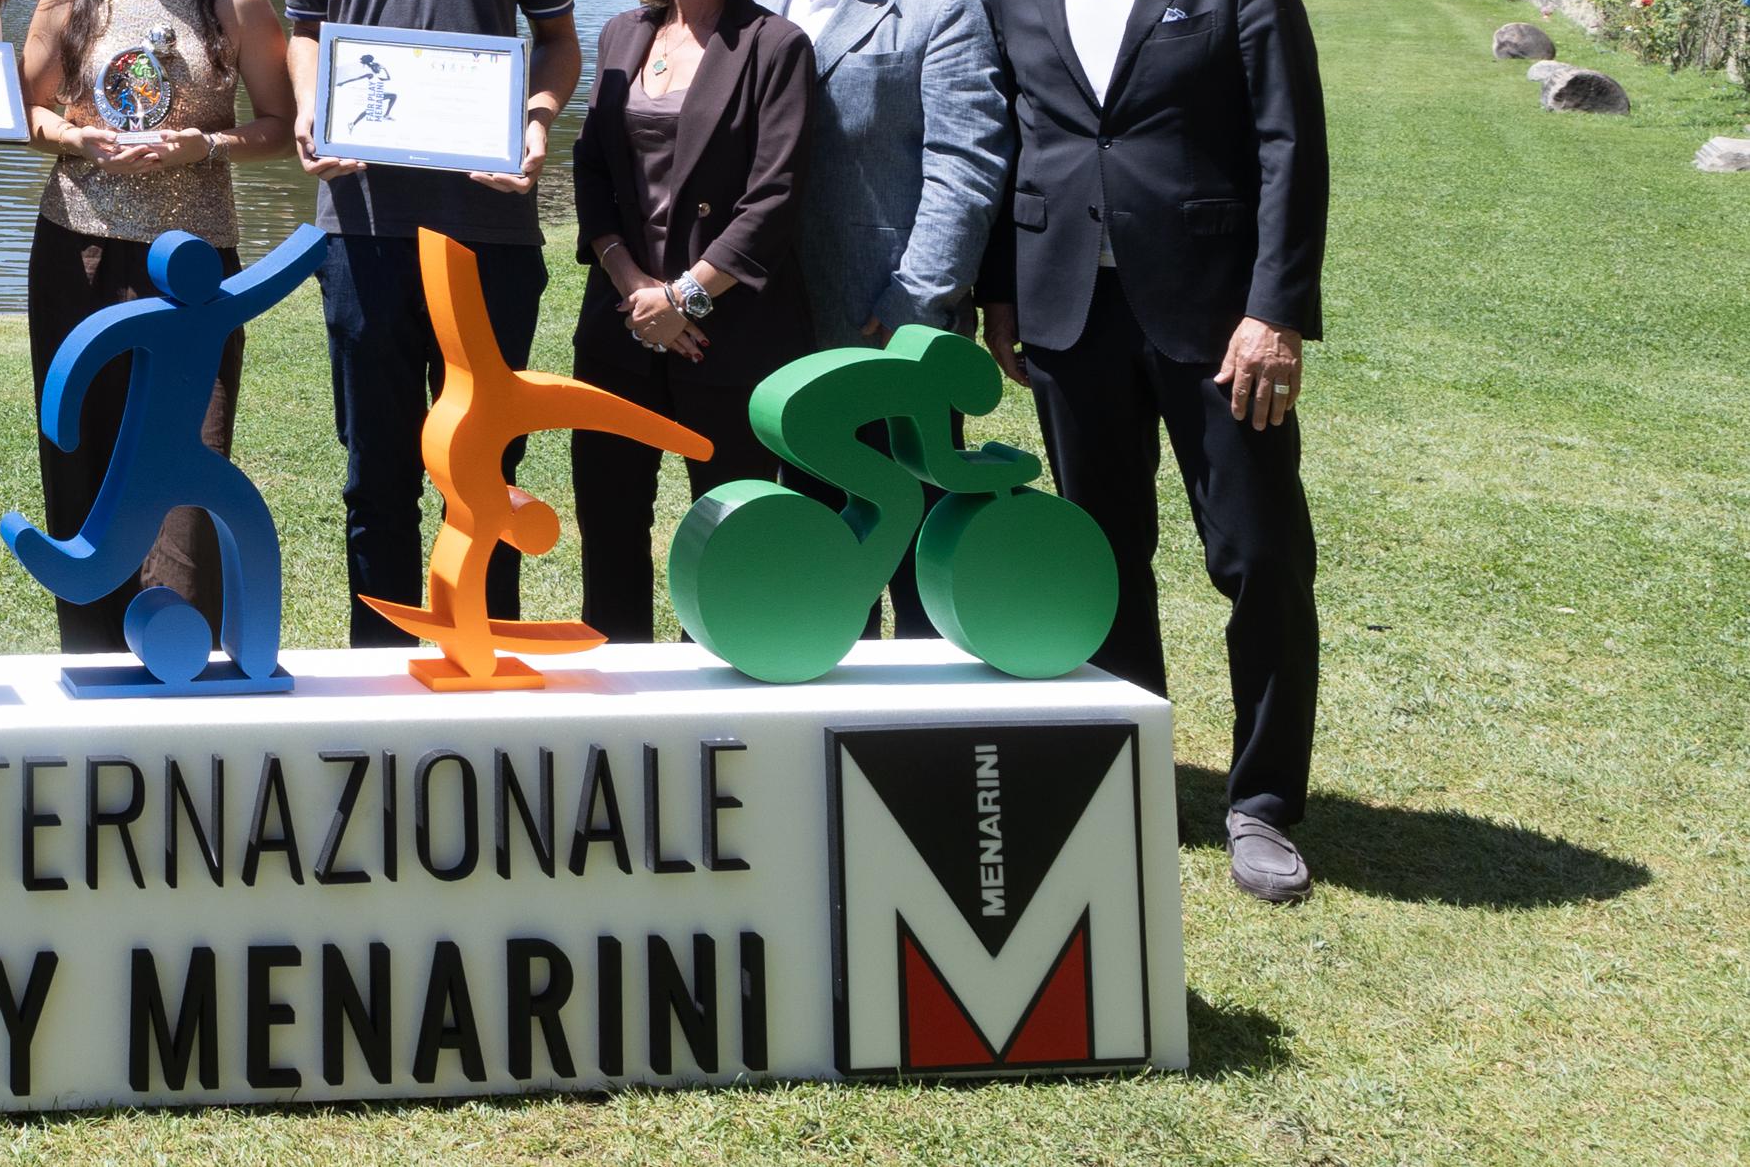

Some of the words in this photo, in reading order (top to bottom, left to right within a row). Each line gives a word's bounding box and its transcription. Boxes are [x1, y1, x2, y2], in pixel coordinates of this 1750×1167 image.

[367, 81, 376, 102] PLAY
[374, 81, 384, 122] MENARINI
[365, 103, 374, 122] FAIR
[975, 744, 1006, 917] MENARINI
[129, 931, 768, 1092] MENARINI
